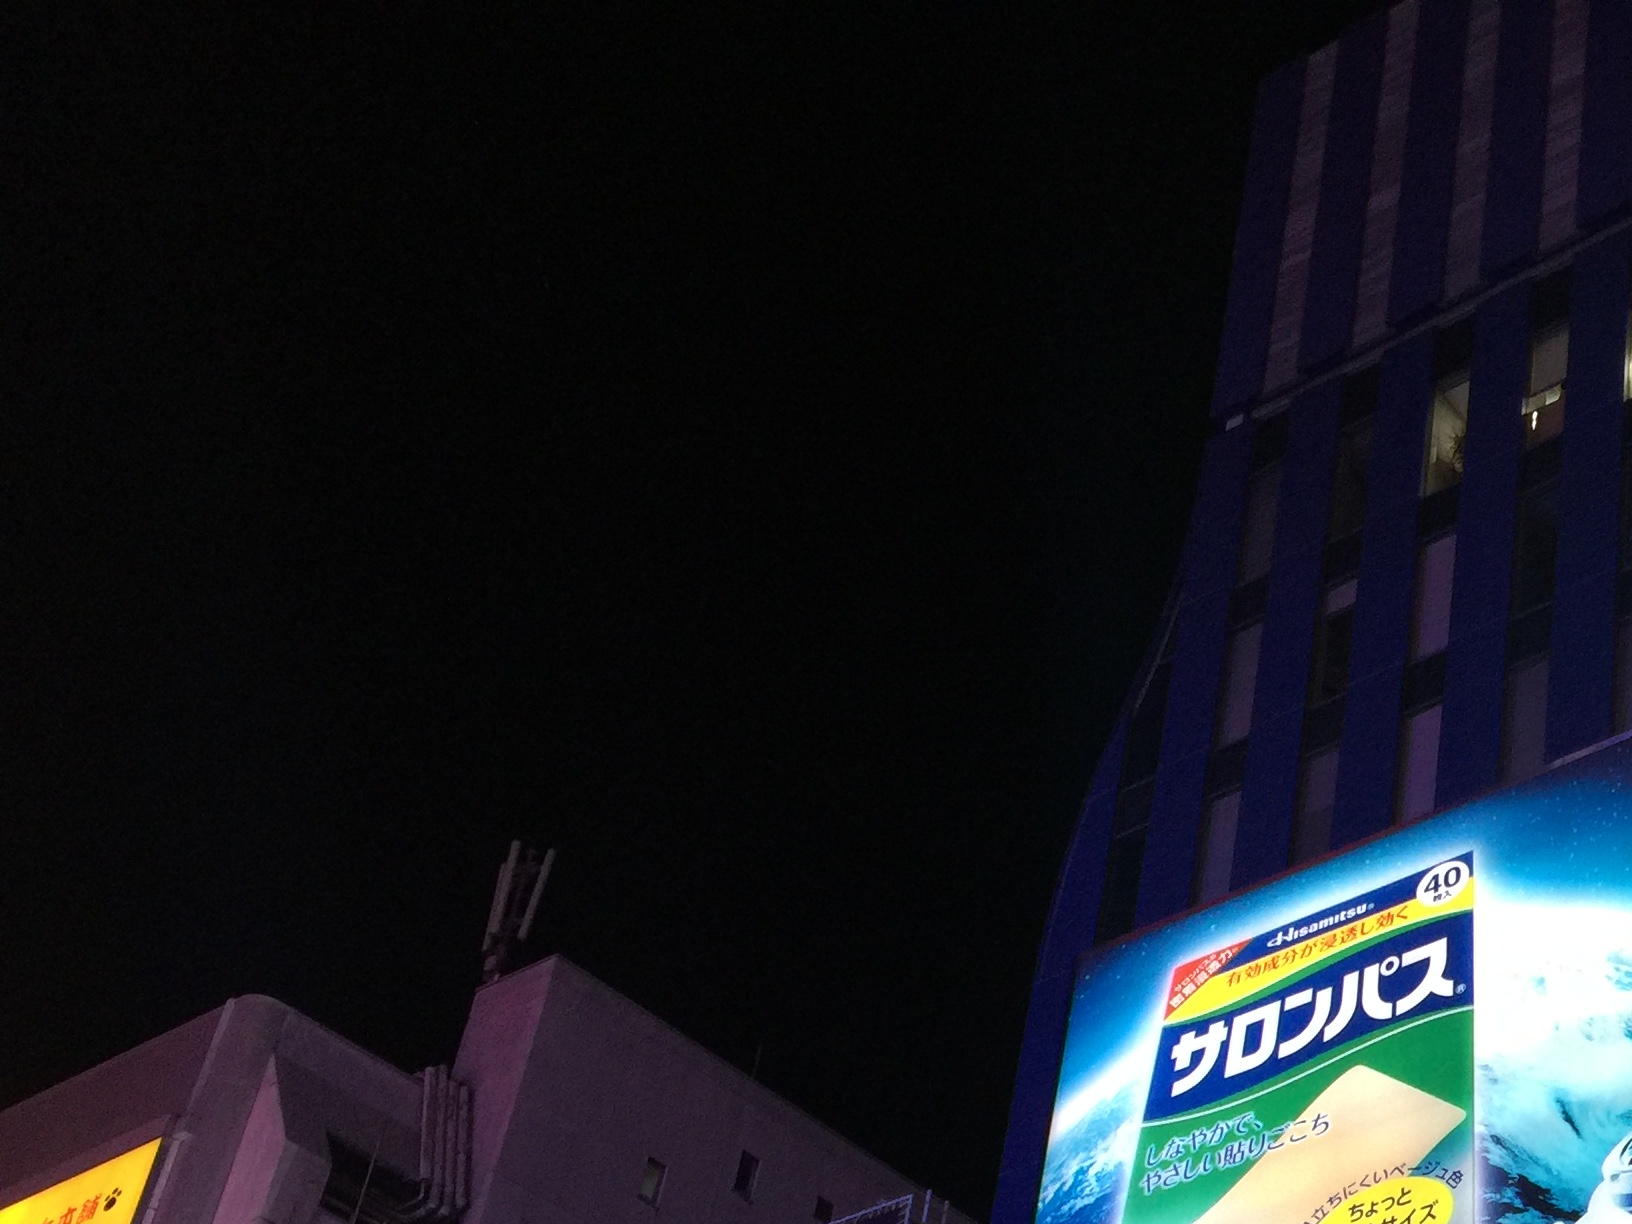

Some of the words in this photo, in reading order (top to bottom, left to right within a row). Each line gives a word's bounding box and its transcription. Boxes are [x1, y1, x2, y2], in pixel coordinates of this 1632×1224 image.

[1424, 866, 1462, 893] 40
[1226, 905, 1408, 987] 有効成分が浸透し効く
[1267, 903, 1367, 947] Hisamitsu
[1170, 937, 1454, 1097] サロンパス
[1142, 1112, 1331, 1193] やさしい貼りごこち
[1145, 1111, 1264, 1167] しなやかで、
[1347, 1187, 1413, 1222] ちょっと
